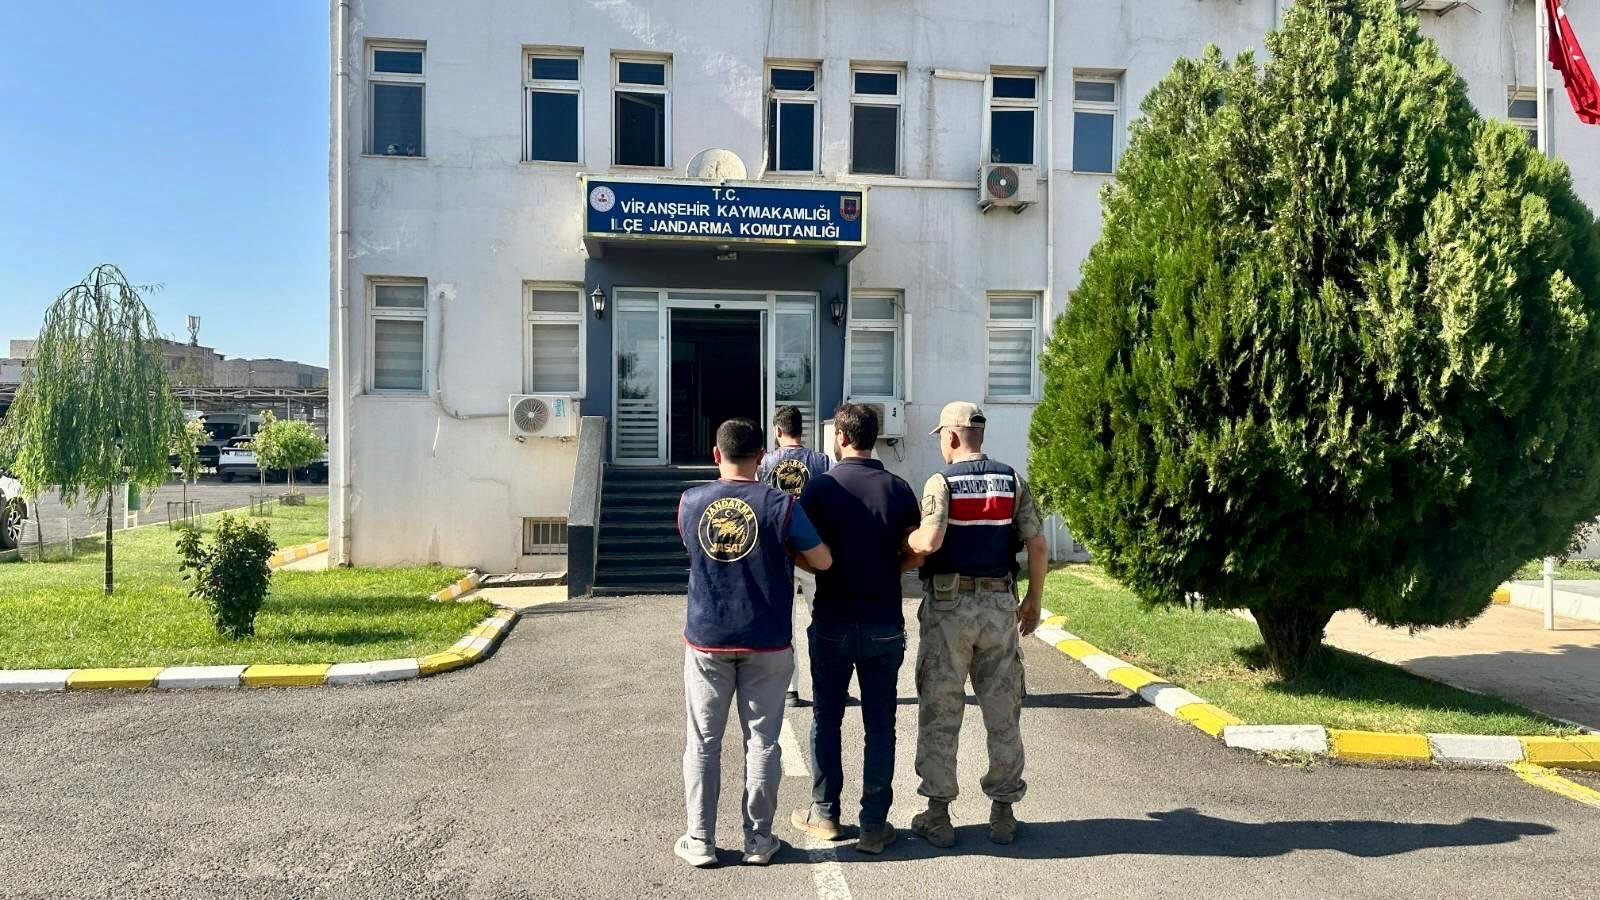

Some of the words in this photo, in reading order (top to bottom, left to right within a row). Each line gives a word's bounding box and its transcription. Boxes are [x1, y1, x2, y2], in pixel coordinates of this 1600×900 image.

[712, 188, 740, 202] T.C.
[620, 199, 710, 218] VİRANŞEHİR
[717, 204, 831, 222] KAYMAKAMLIĞI
[649, 220, 733, 235] JANDARMA
[740, 222, 840, 239] KOMUTANLIĞI
[956, 479, 1010, 494] JANDARMA
[705, 500, 754, 521] JANDARMA
[710, 542, 743, 553] JASAT
